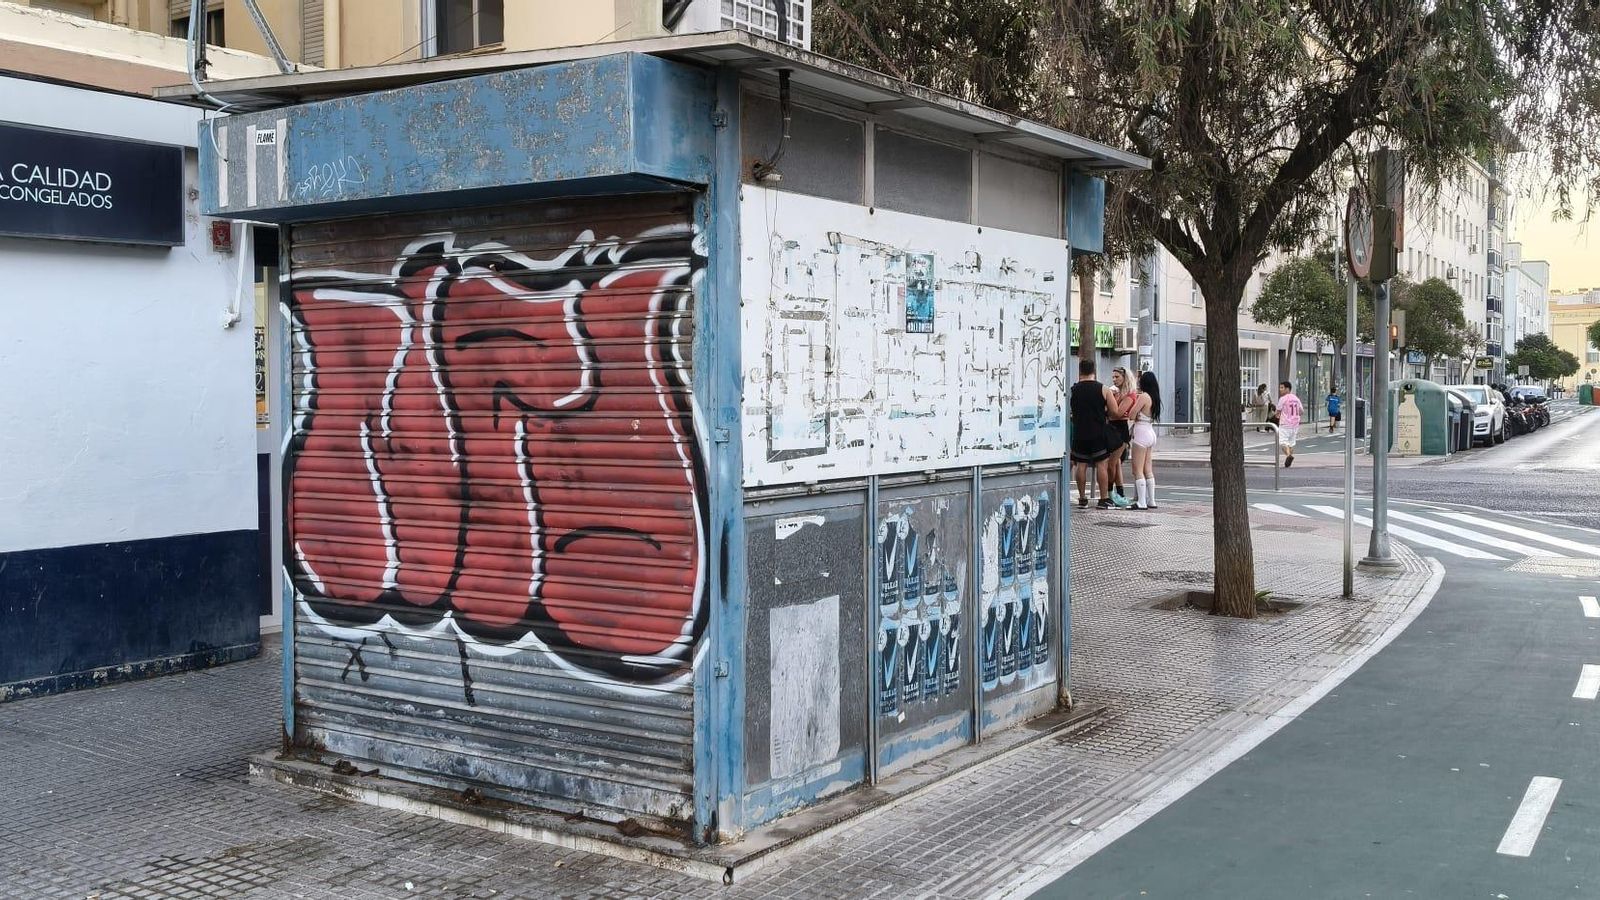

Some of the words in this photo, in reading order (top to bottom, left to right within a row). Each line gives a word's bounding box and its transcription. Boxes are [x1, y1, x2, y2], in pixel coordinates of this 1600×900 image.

[256, 132, 274, 143] FLAME
[11, 163, 112, 191] CALIDAD
[0, 184, 113, 209] CONGELADOS
[1289, 403, 1298, 416] 11
